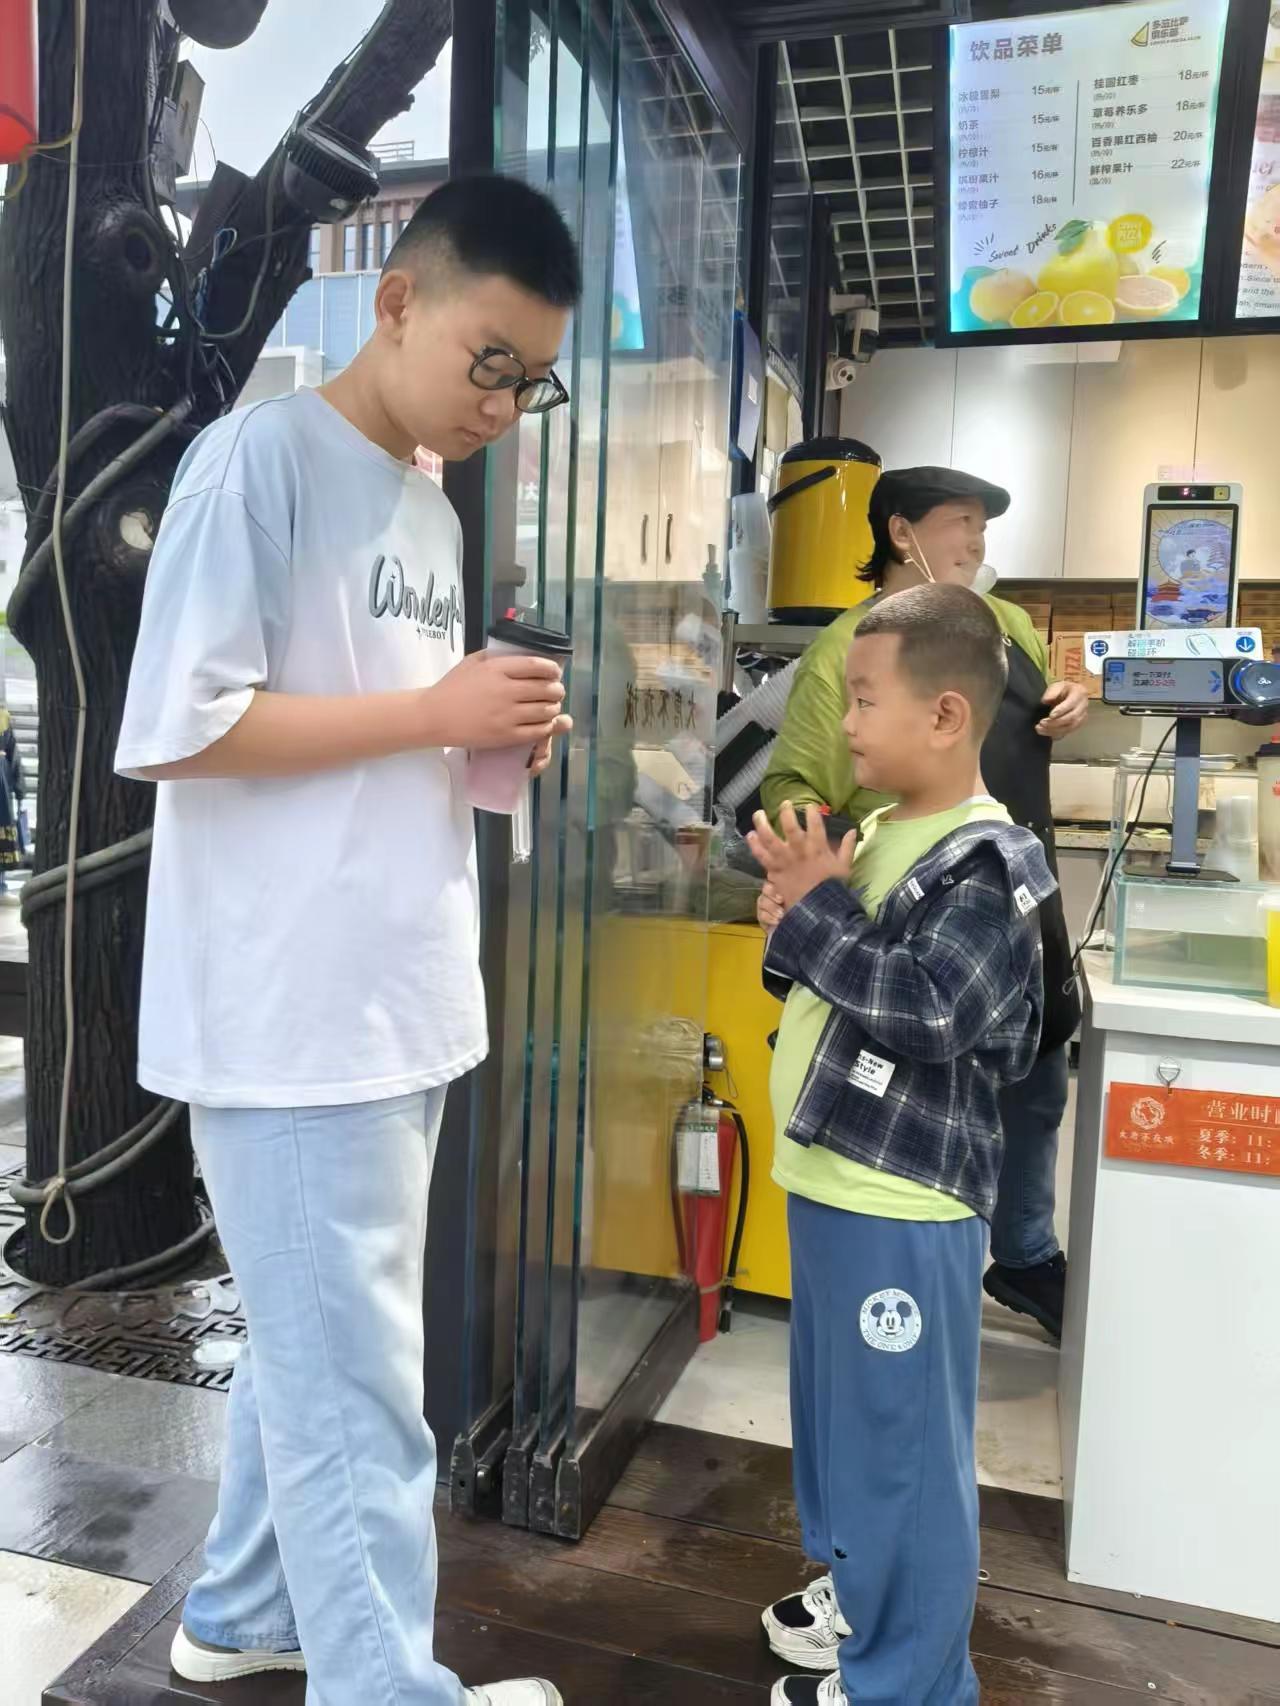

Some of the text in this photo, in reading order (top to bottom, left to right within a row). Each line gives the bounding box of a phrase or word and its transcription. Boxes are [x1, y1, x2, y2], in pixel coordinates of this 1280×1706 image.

[969, 32, 1064, 61] 饮品菜单
[1094, 75, 1139, 89] 桂圆红枣
[1092, 104, 1148, 118] 草莓养乐多
[958, 120, 979, 130] 奶茶
[1091, 133, 1158, 148] 百香果红西柚
[1090, 162, 1134, 176] 鲜榨果汁
[989, 223, 1058, 263] Sweet Drinks
